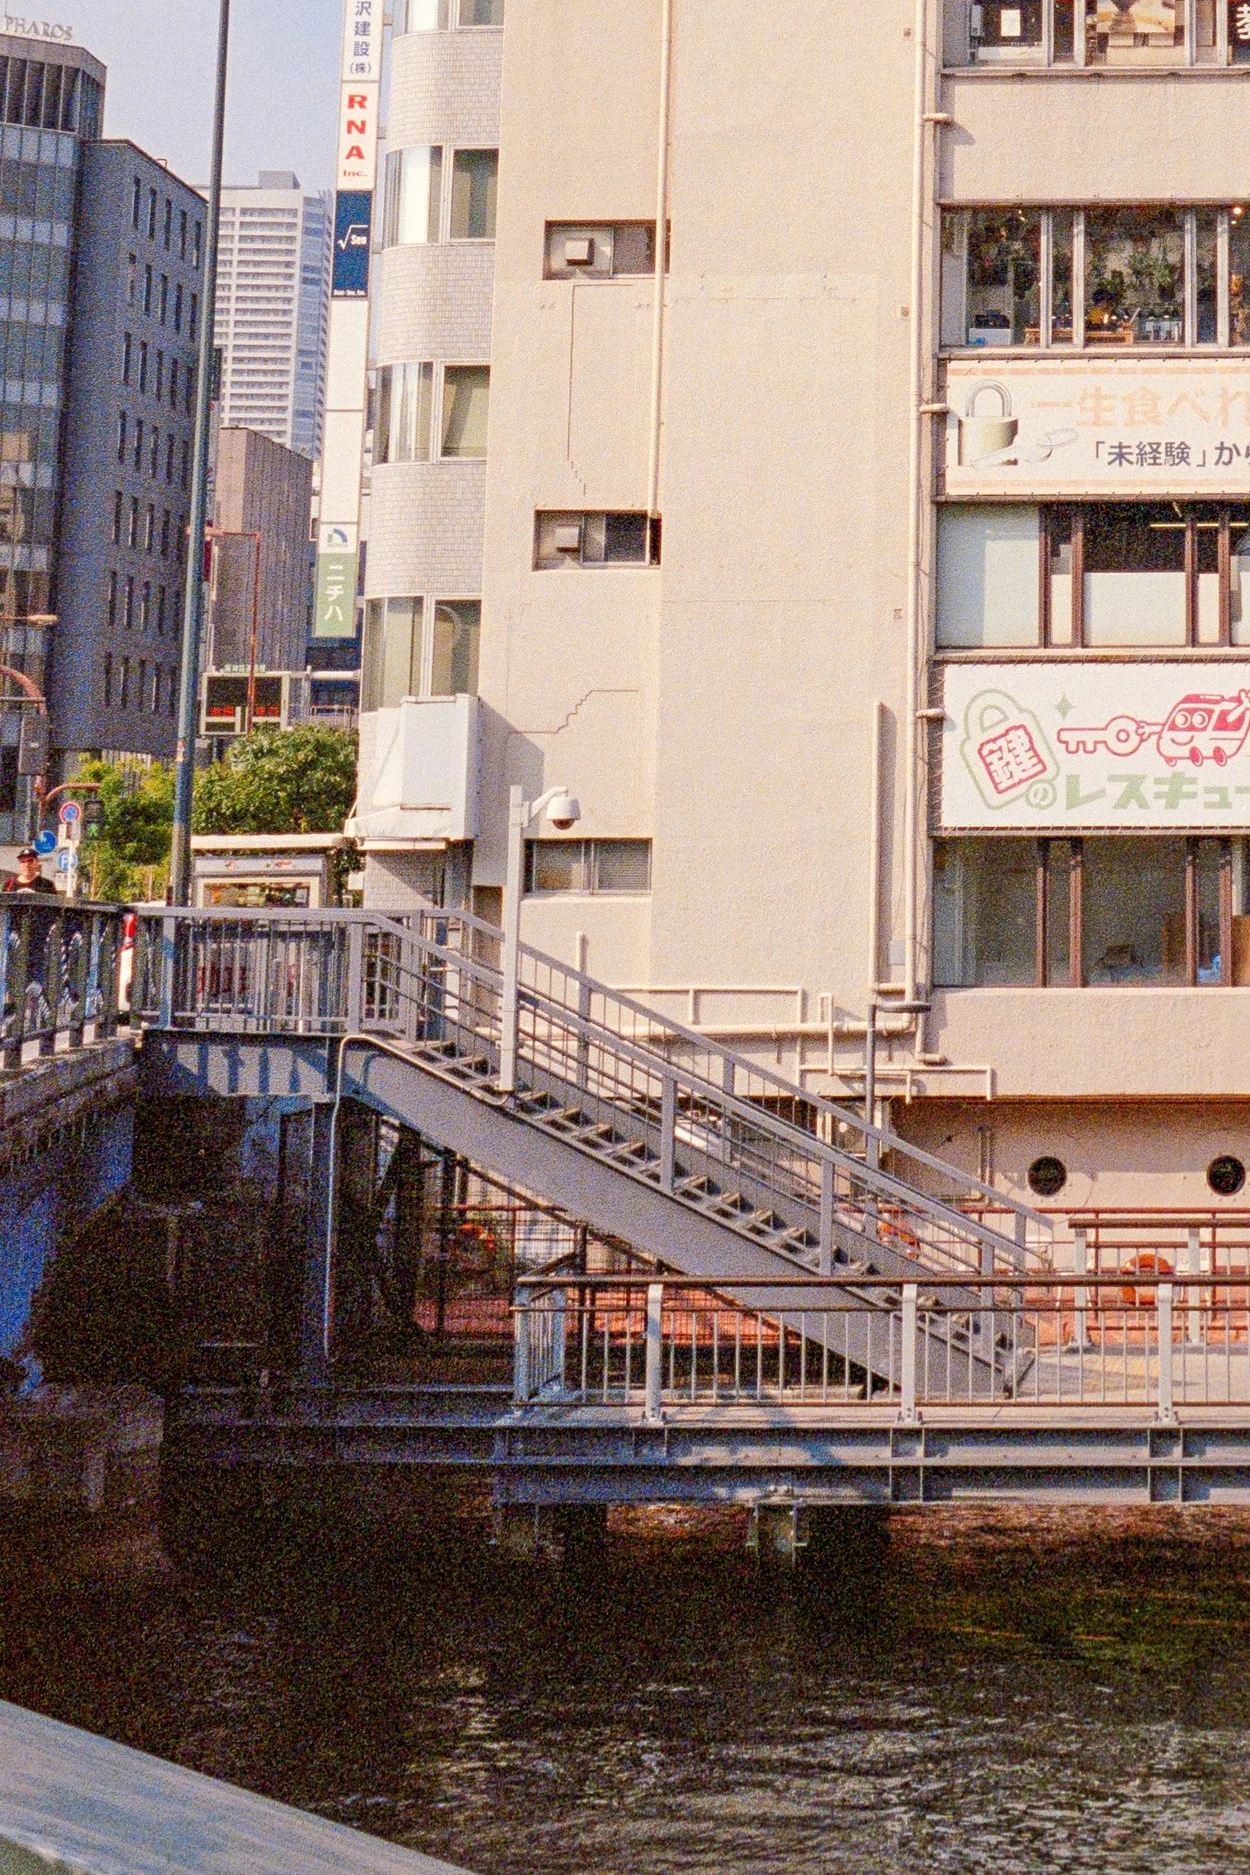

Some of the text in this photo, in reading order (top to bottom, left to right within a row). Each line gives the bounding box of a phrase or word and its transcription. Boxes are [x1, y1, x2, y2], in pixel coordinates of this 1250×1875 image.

[4, 14, 73, 41] PHAROS
[325, 565, 345, 621] ニチハ
